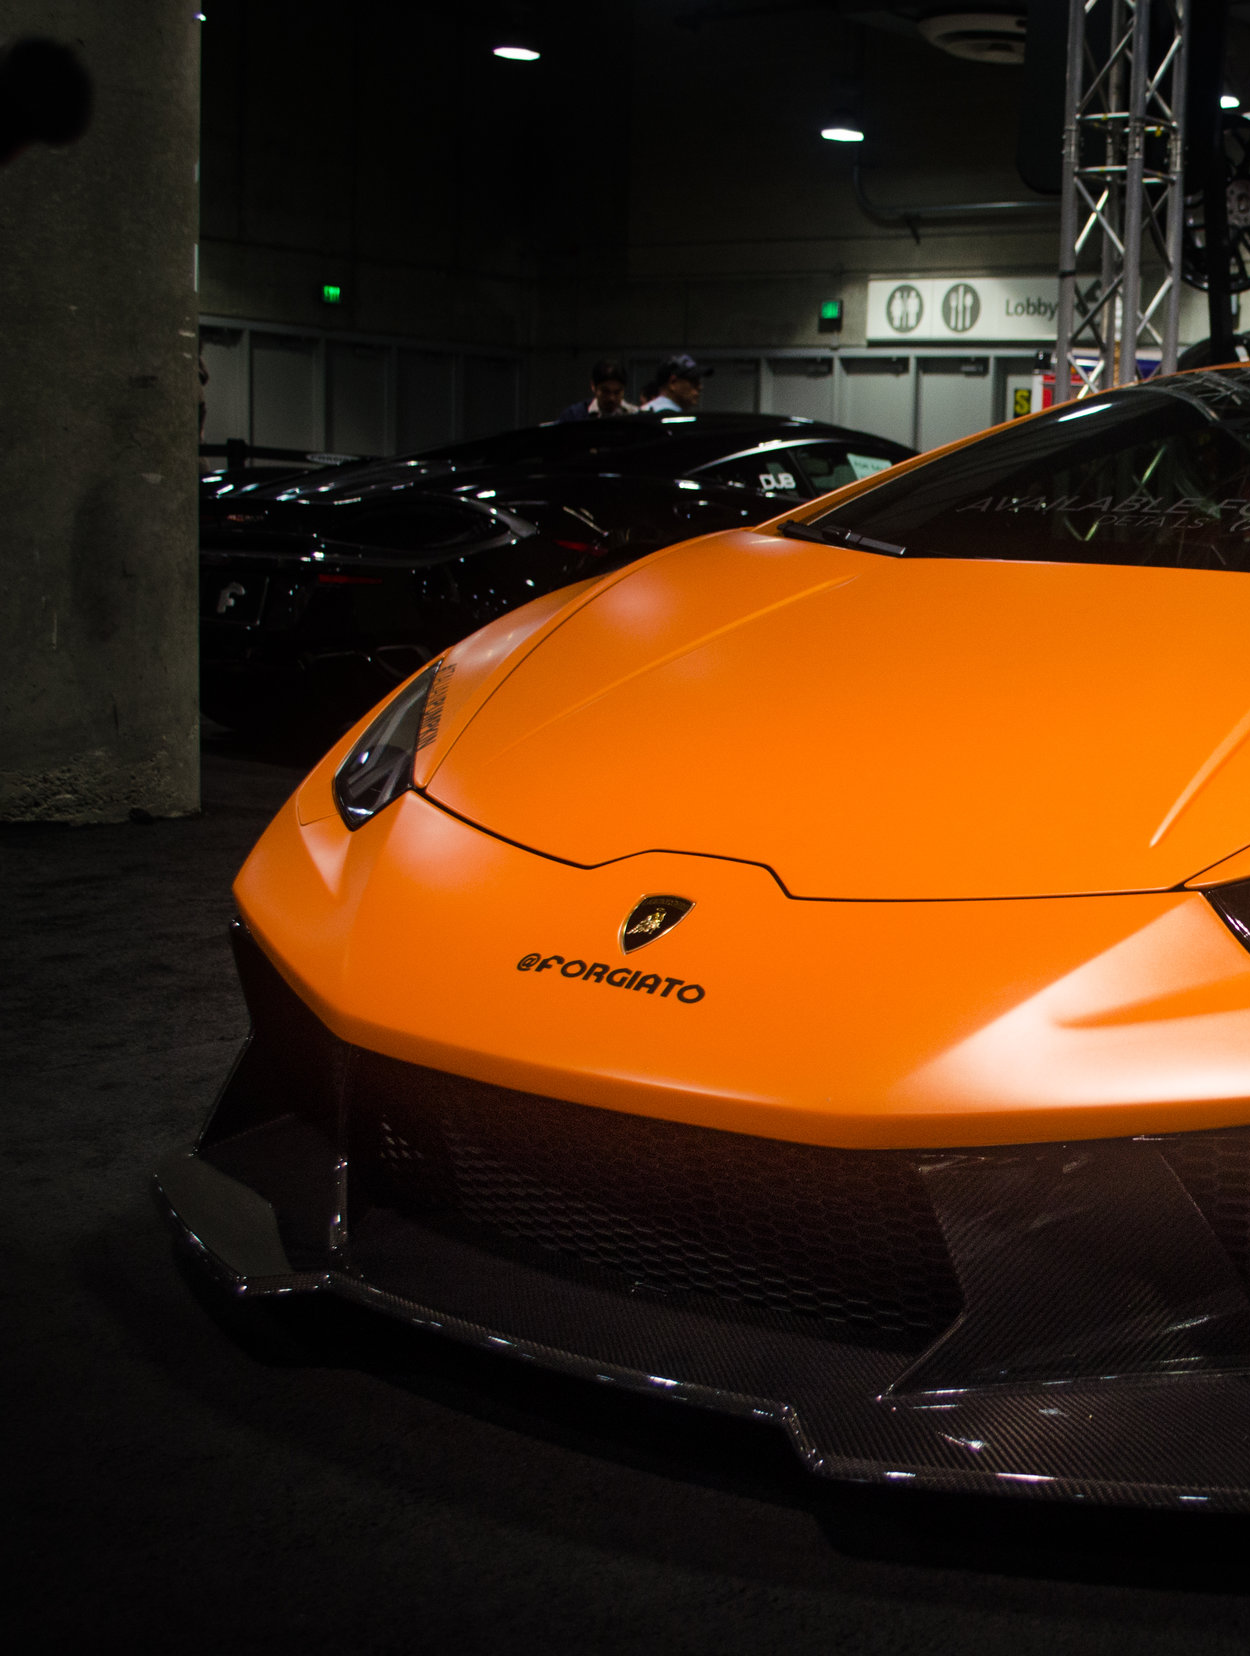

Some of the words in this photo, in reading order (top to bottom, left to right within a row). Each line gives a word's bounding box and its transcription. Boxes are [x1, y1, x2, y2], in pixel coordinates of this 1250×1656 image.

[1006, 297, 1059, 321] Lobby
[759, 472, 796, 490] DUB
[516, 953, 706, 1004] @FORGIATO
